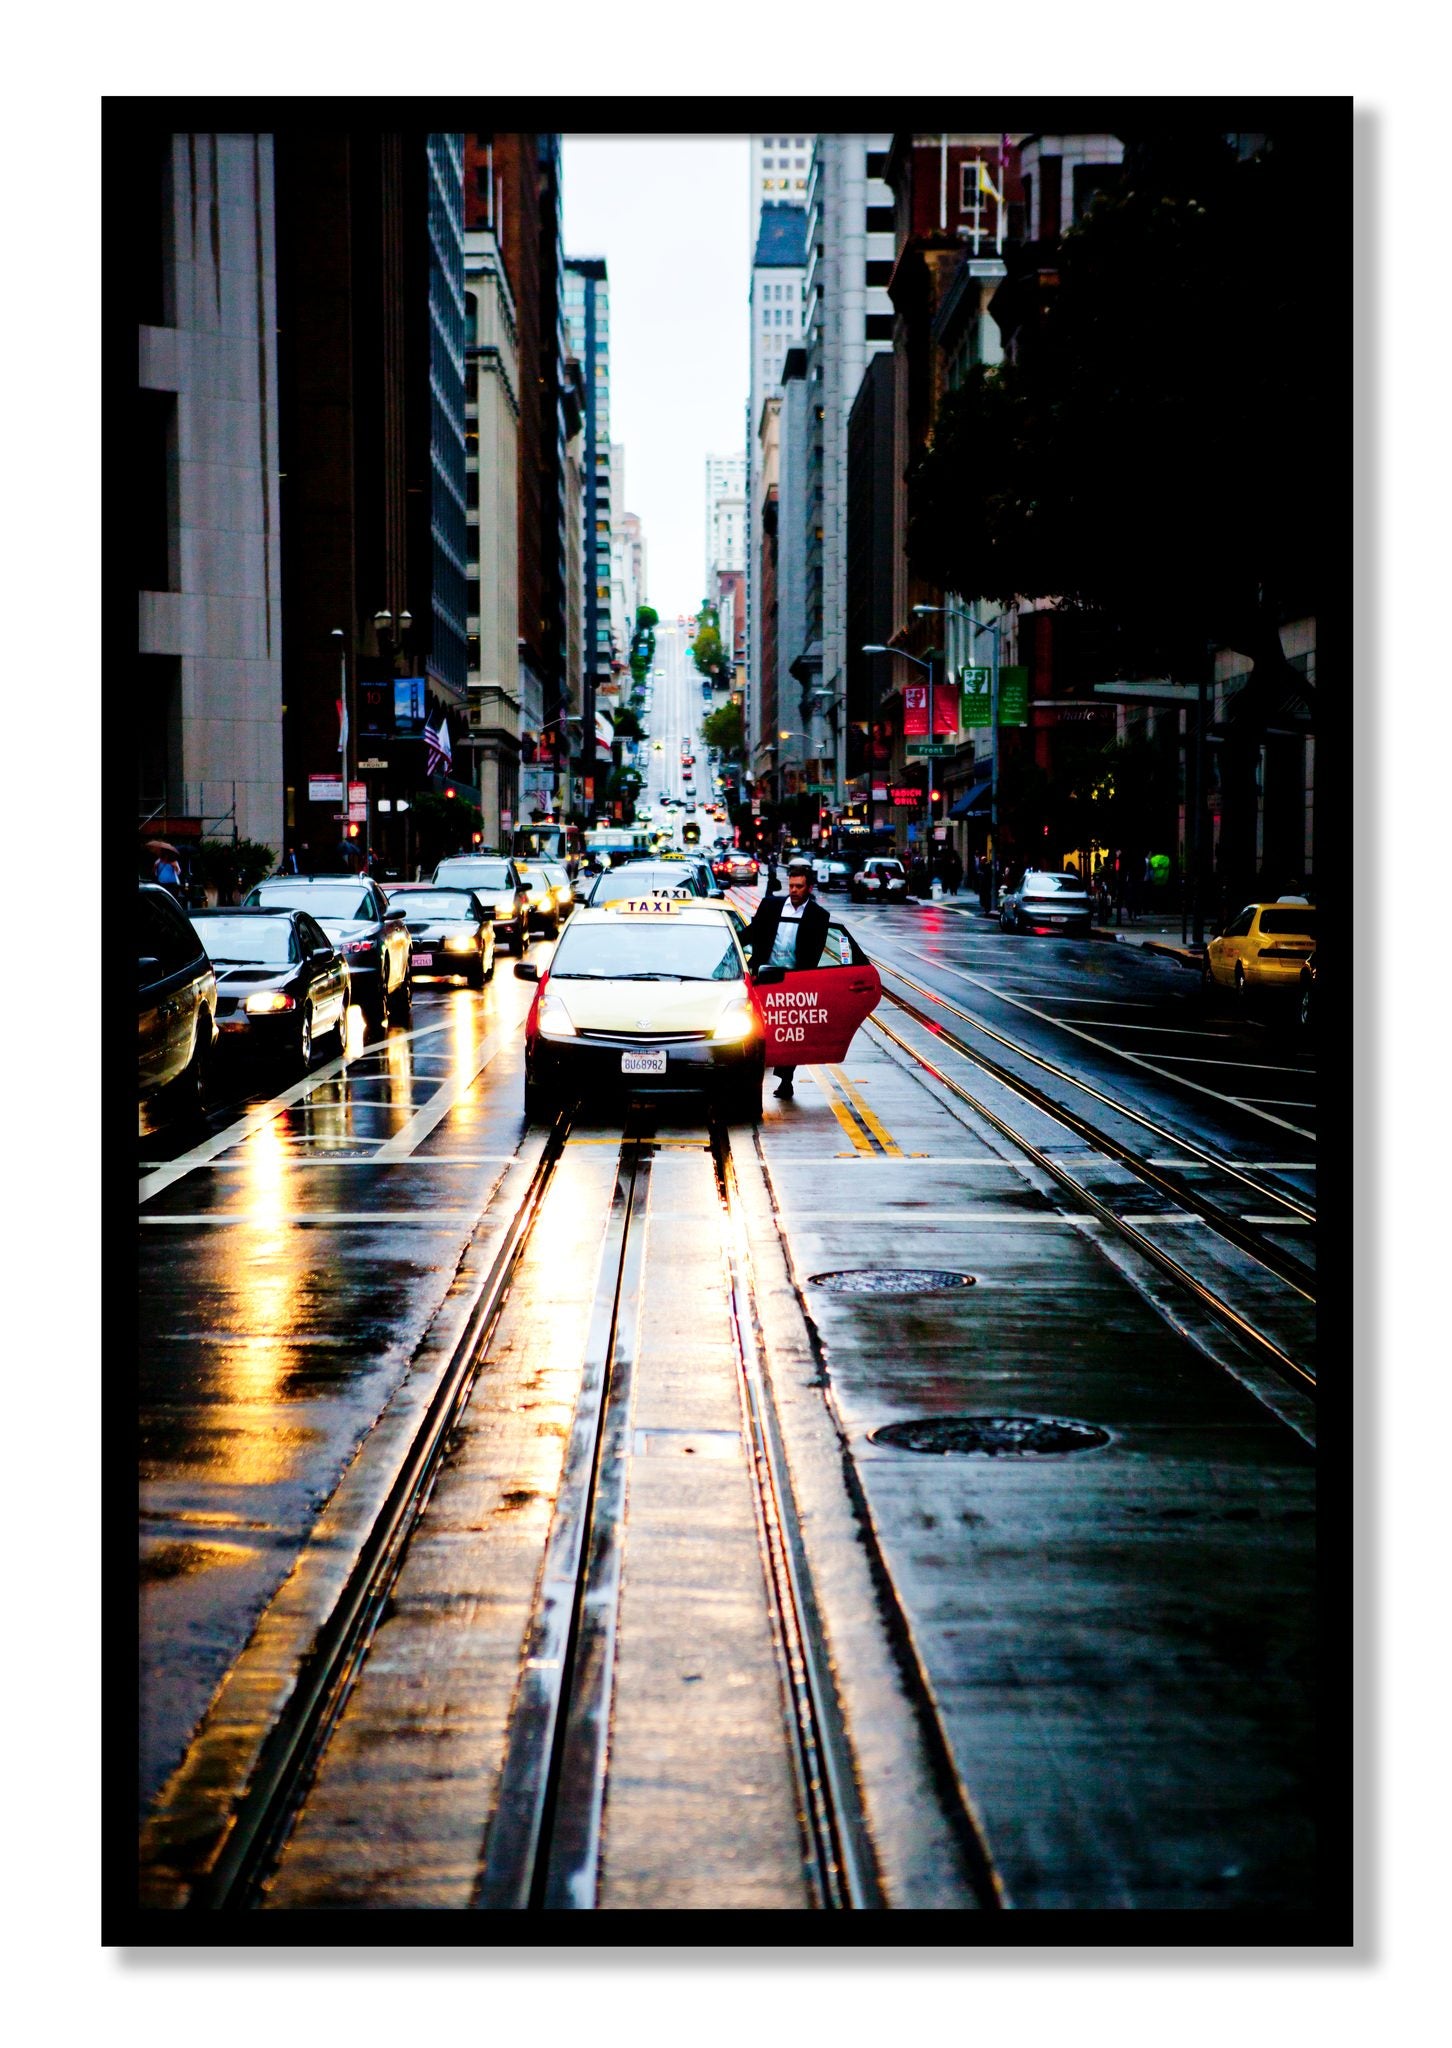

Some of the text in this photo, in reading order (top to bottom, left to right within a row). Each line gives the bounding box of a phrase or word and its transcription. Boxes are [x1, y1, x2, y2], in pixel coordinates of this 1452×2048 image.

[919, 746, 943, 754] Front
[890, 789, 922, 797] TADICH
[894, 798, 918, 806] GRILL
[652, 890, 687, 898] TAXI
[628, 901, 671, 912] TAXI
[765, 991, 818, 1008] ARROW
[774, 1027, 805, 1043] CAB
[624, 1059, 663, 1070] 8U68982
